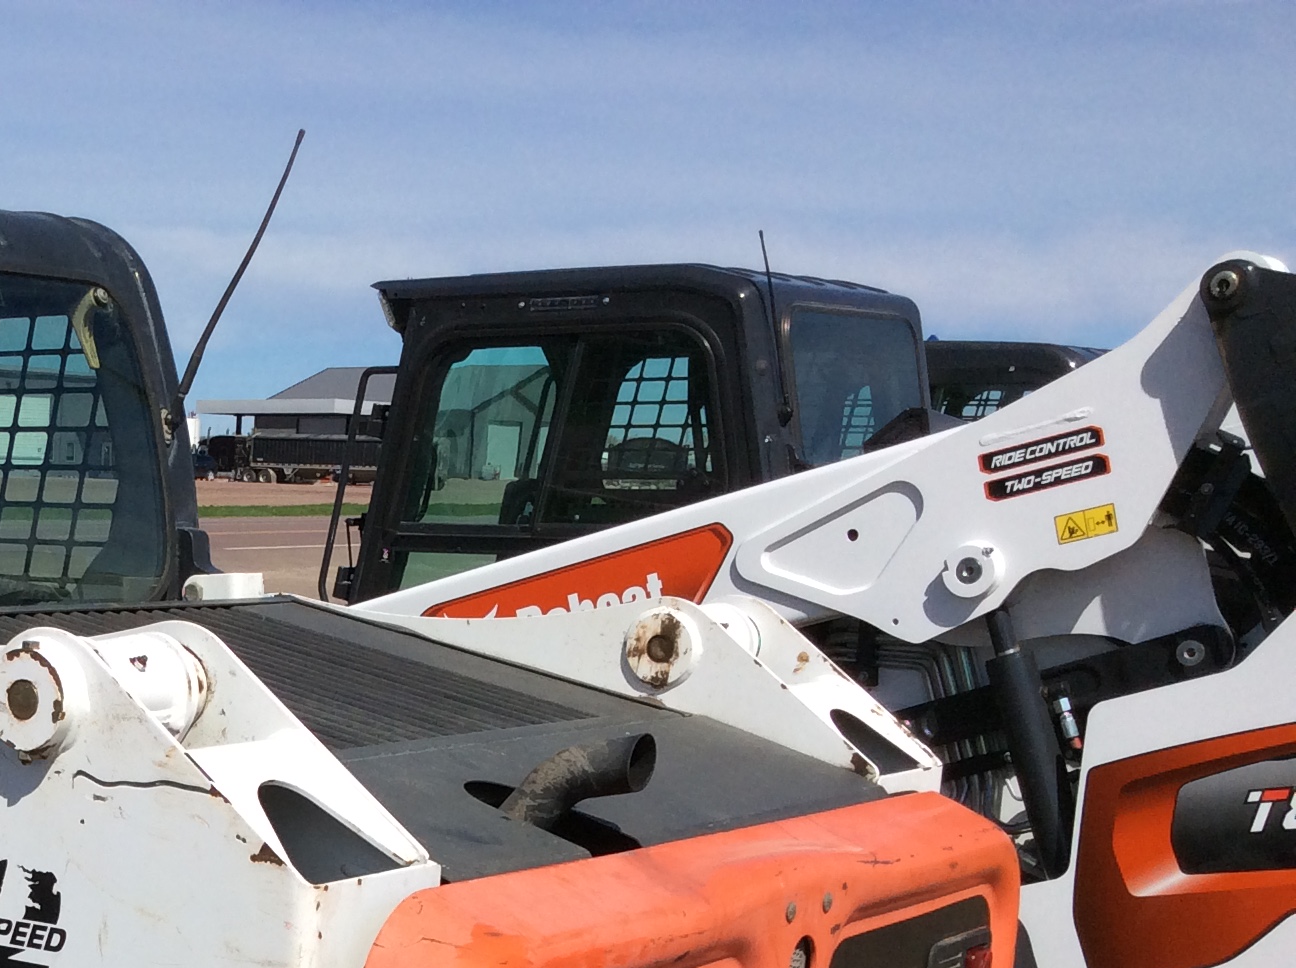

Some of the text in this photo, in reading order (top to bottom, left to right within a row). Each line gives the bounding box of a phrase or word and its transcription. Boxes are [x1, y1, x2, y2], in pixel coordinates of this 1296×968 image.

[990, 431, 1096, 469] RIDE CONTROL
[1004, 460, 1093, 494] TWO-SPEED
